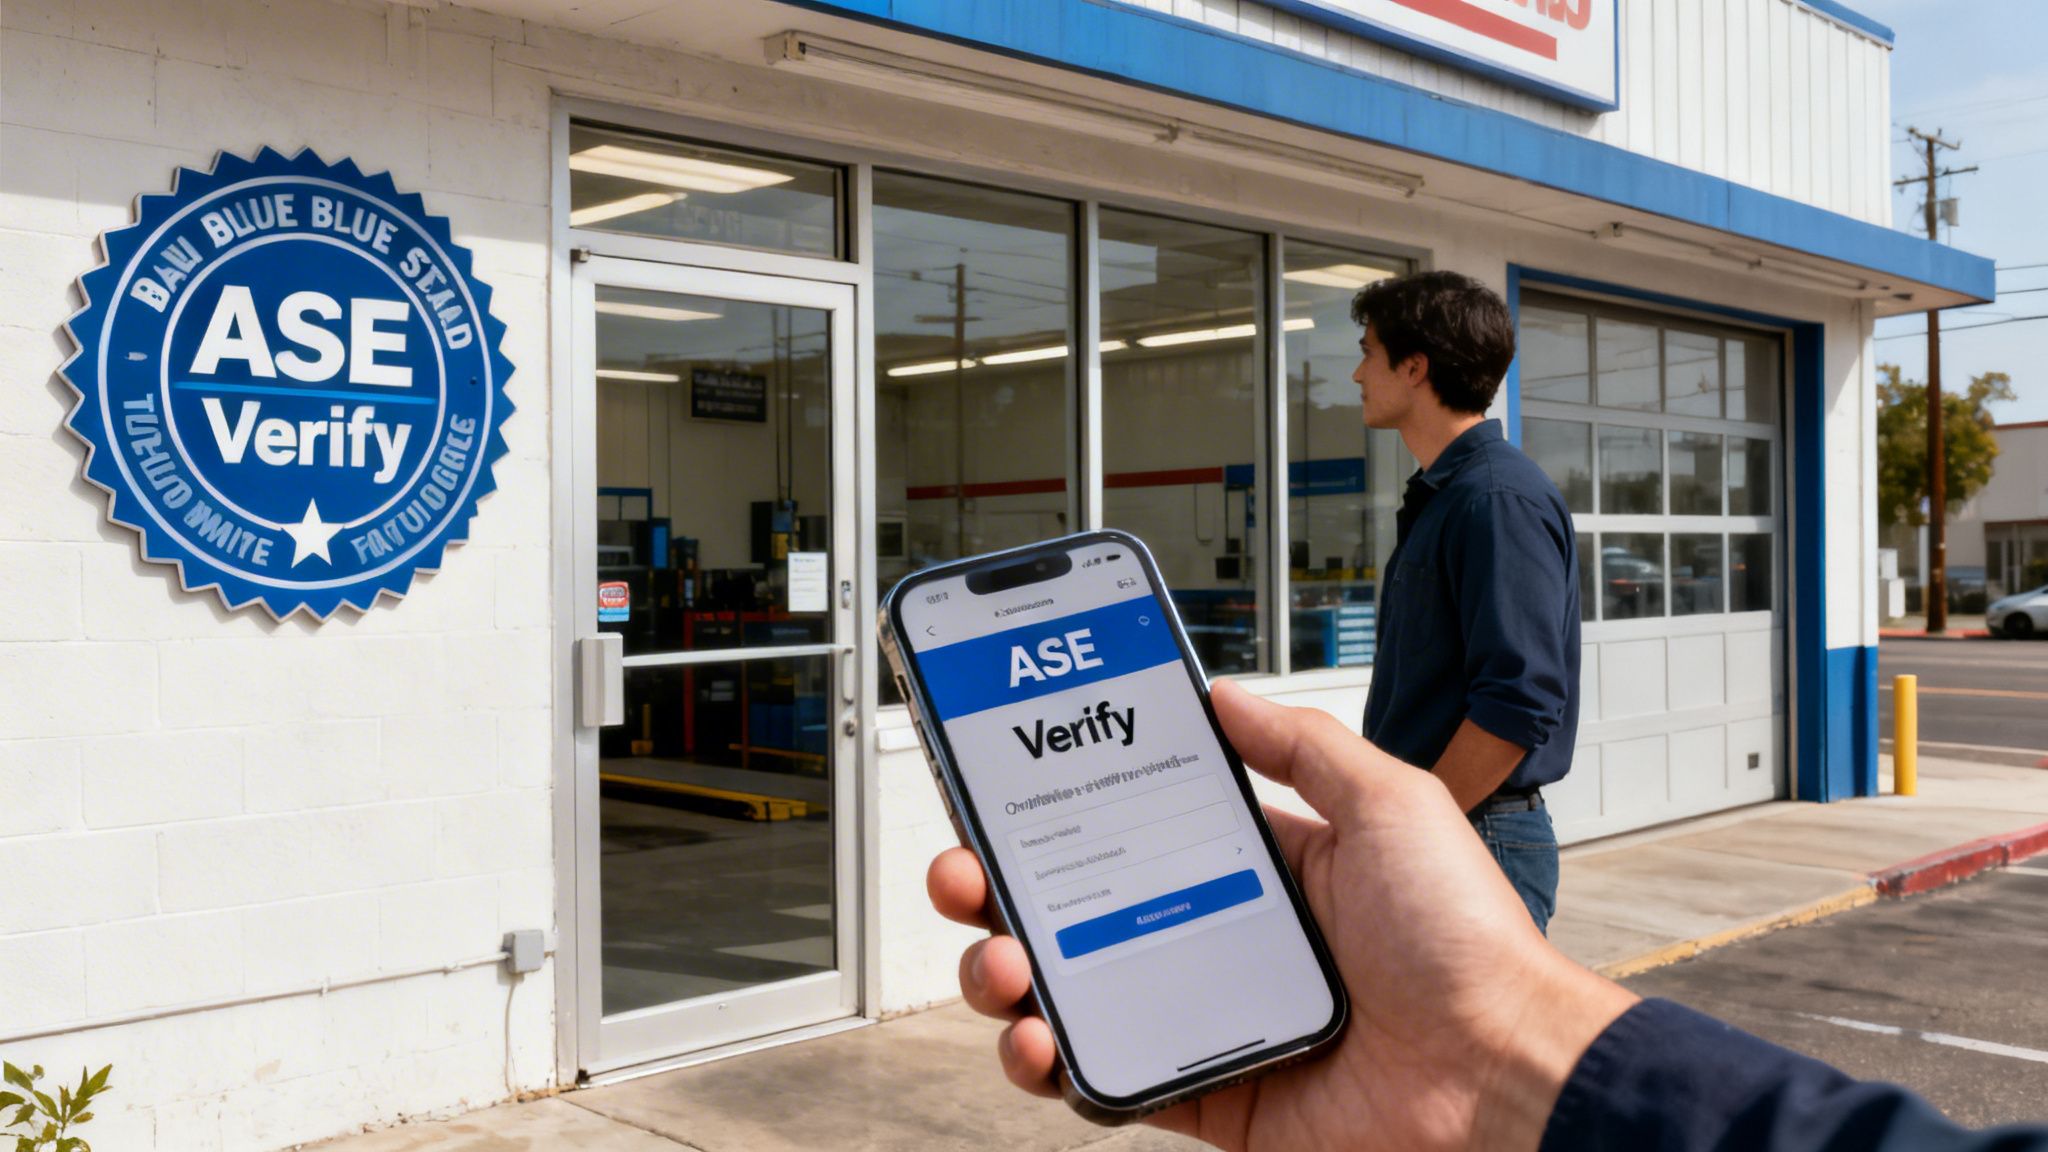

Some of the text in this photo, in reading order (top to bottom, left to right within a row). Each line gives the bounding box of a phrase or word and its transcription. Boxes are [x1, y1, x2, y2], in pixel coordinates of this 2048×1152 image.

[311, 195, 399, 255] BLUE
[188, 284, 414, 388] ASE
[201, 397, 413, 484] Verify
[1008, 627, 1104, 688] ASE
[1012, 700, 1136, 760] Verify
